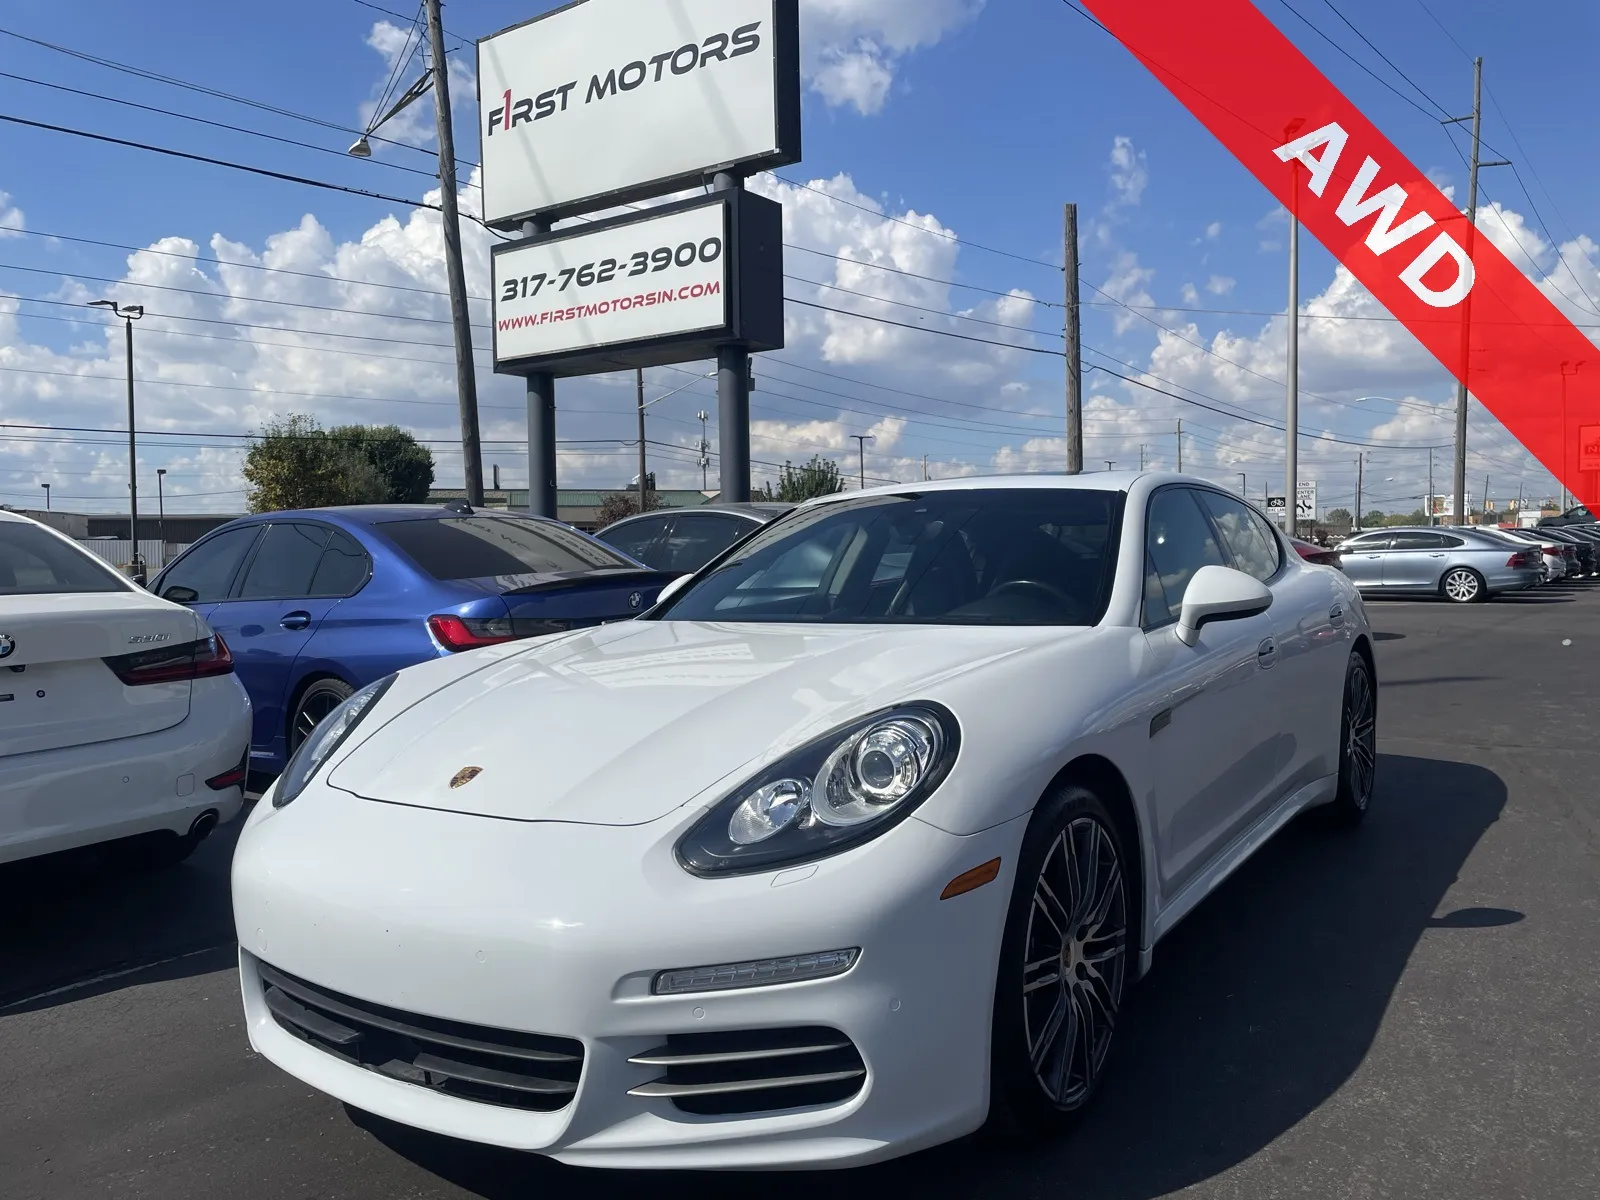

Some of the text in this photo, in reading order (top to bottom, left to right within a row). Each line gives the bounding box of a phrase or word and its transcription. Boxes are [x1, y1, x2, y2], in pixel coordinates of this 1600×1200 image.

[585, 21, 762, 104] MOTORS
[500, 237, 722, 302] 317-762-3900
[498, 280, 721, 332] WWW.FIRSTMOTORSIN.COM
